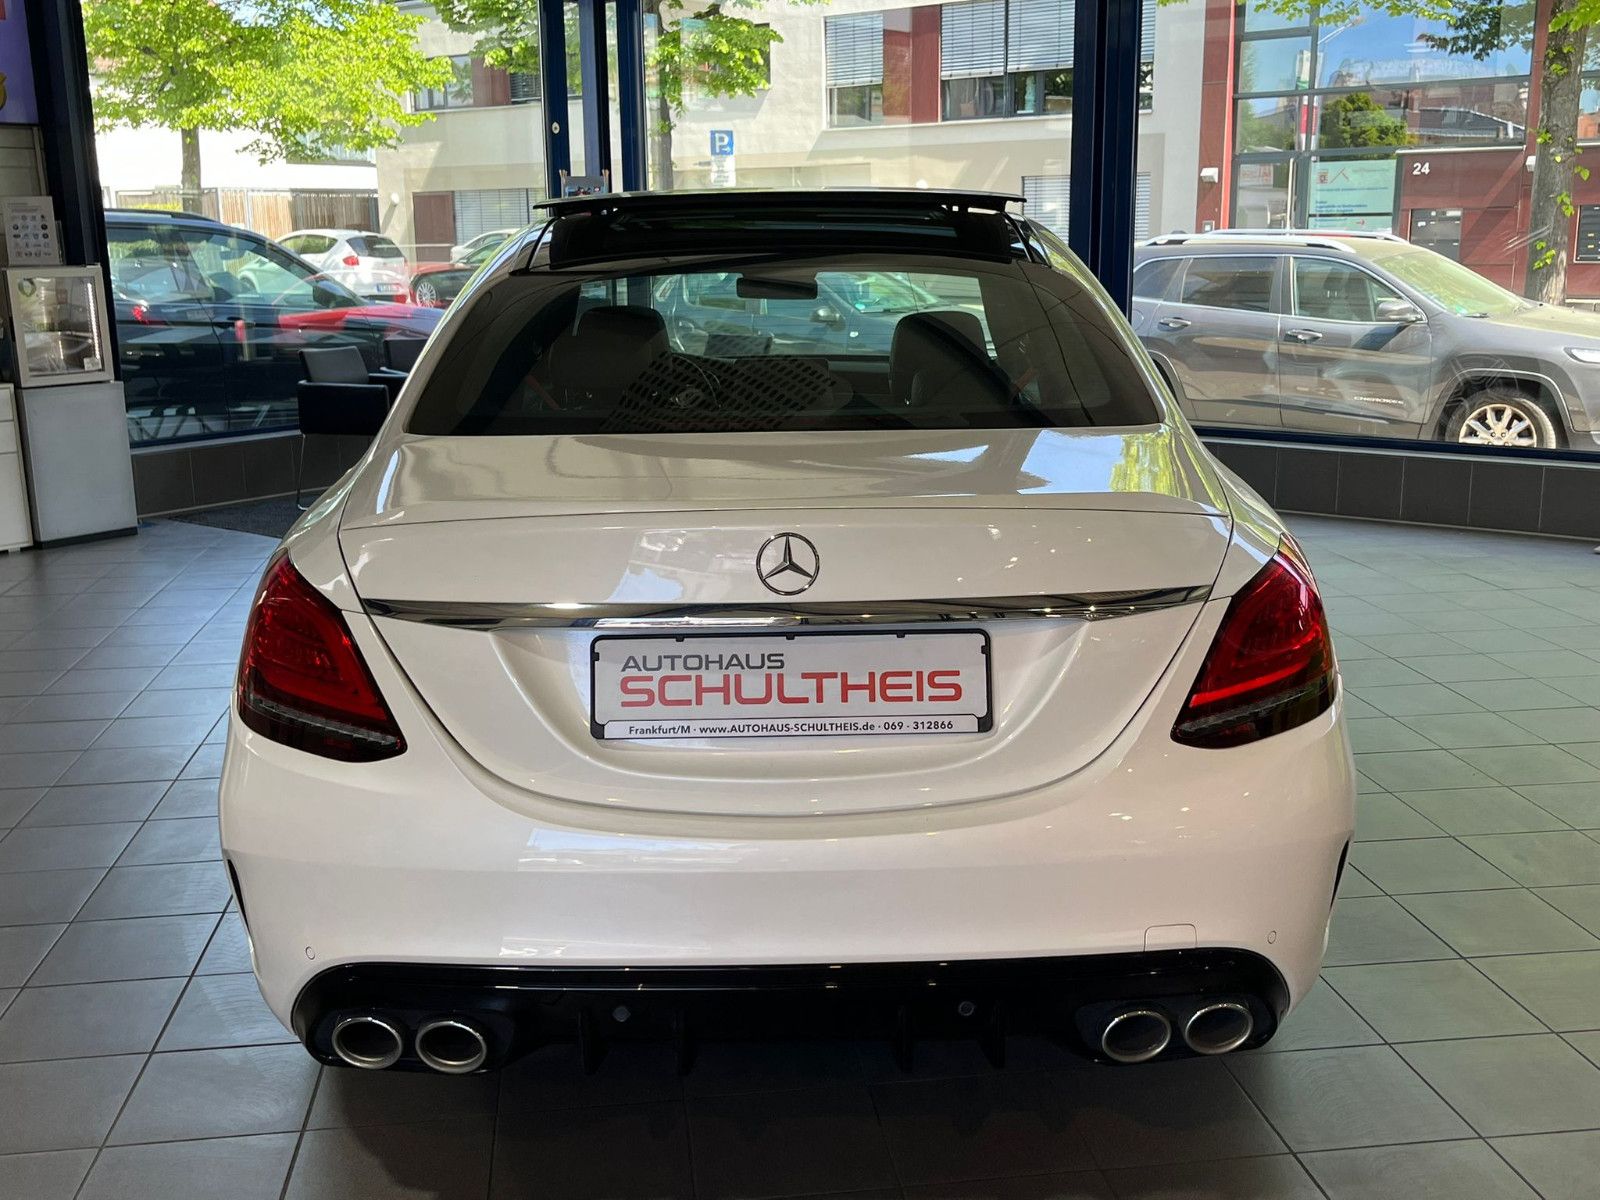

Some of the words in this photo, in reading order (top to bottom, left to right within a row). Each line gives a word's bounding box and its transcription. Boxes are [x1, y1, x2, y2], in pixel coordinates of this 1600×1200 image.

[715, 132, 729, 153] P
[1412, 162, 1430, 176] 24
[620, 653, 785, 672] AUTOHAUS
[620, 670, 962, 708] SCHULTHEIS
[628, 725, 691, 735] Frankfurt/M
[699, 722, 875, 733] www.AUTOHAUS-SCHULTHEIS.de
[883, 721, 904, 731] 069
[912, 720, 954, 730] 312866
